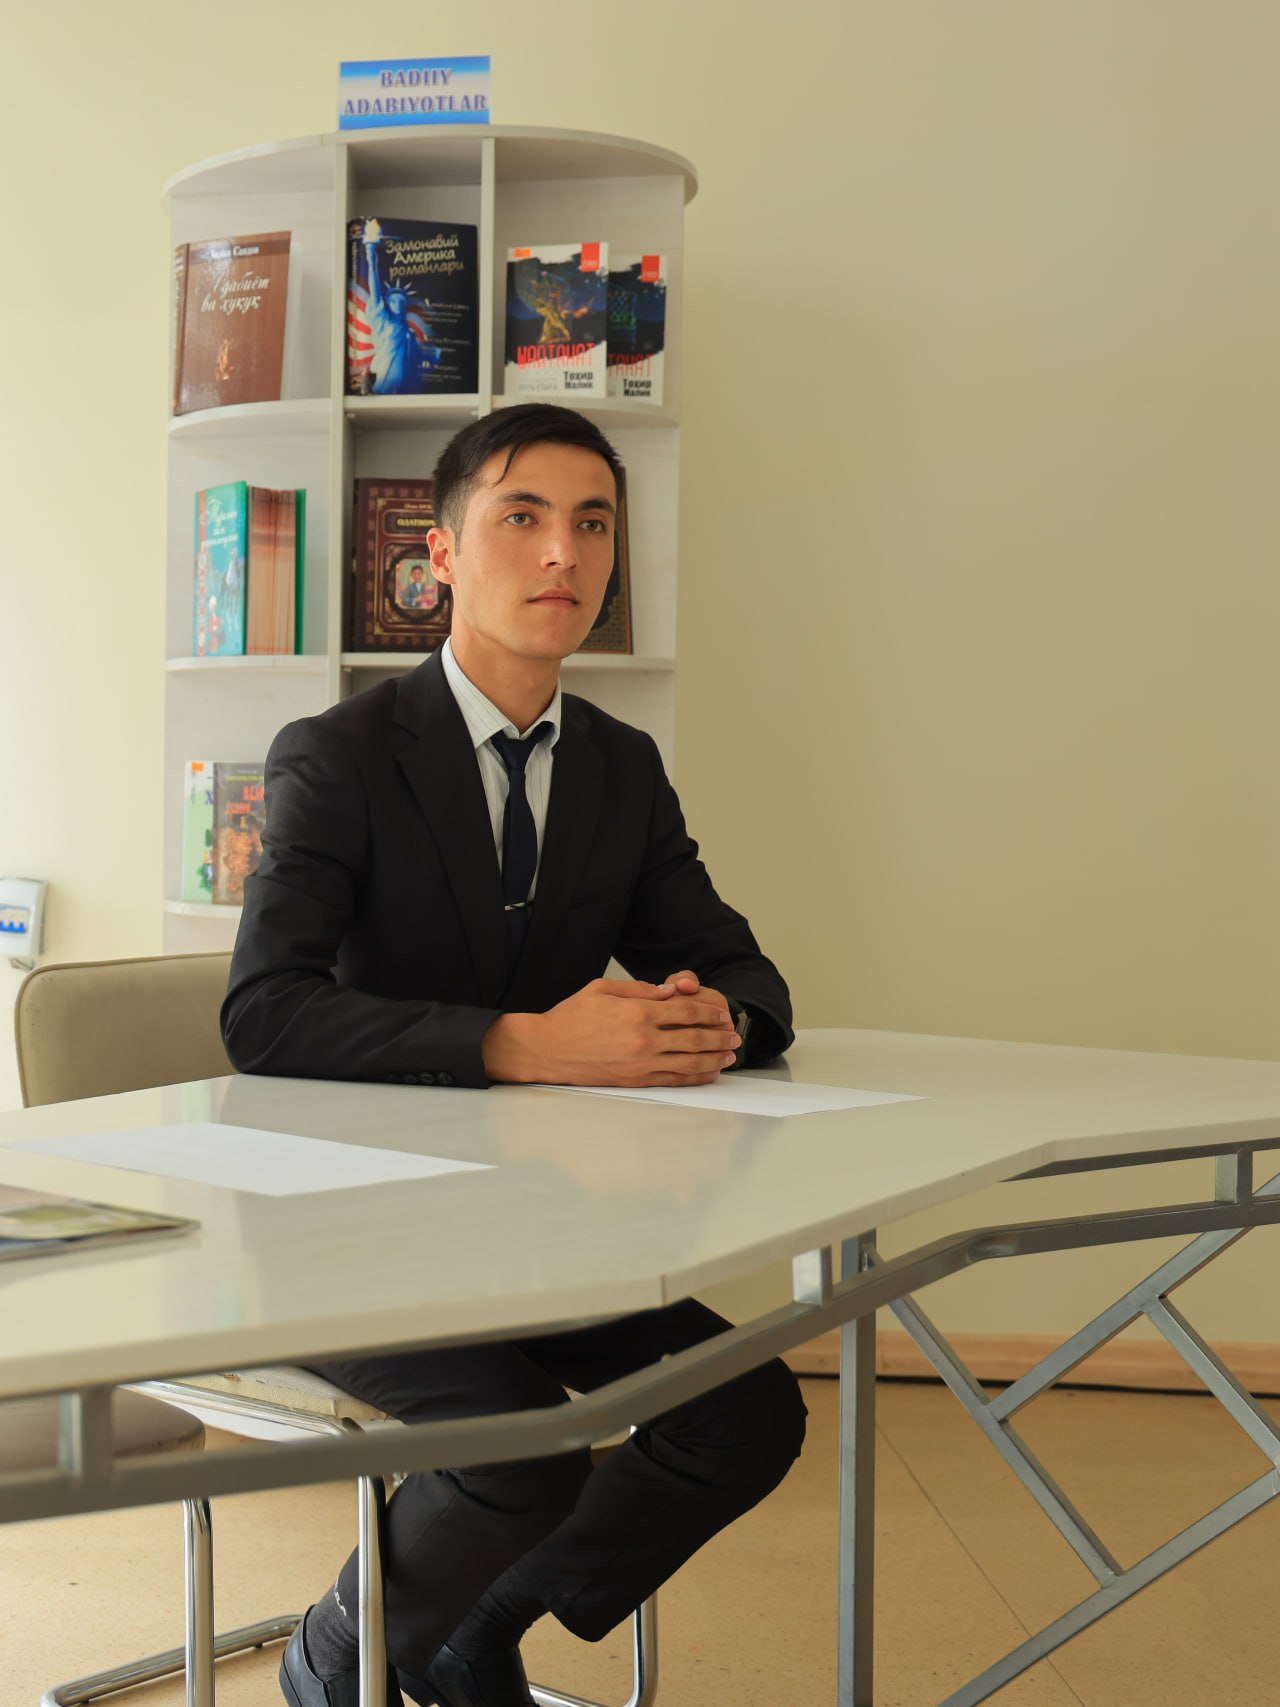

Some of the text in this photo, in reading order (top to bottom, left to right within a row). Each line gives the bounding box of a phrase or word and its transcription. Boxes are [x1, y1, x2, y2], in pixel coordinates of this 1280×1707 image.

[381, 67, 452, 88] BADIIY
[343, 94, 488, 117] ADABIYOTLAR
[385, 233, 459, 255] Замонавий
[393, 248, 457, 266] Америка
[389, 260, 464, 281] романлари
